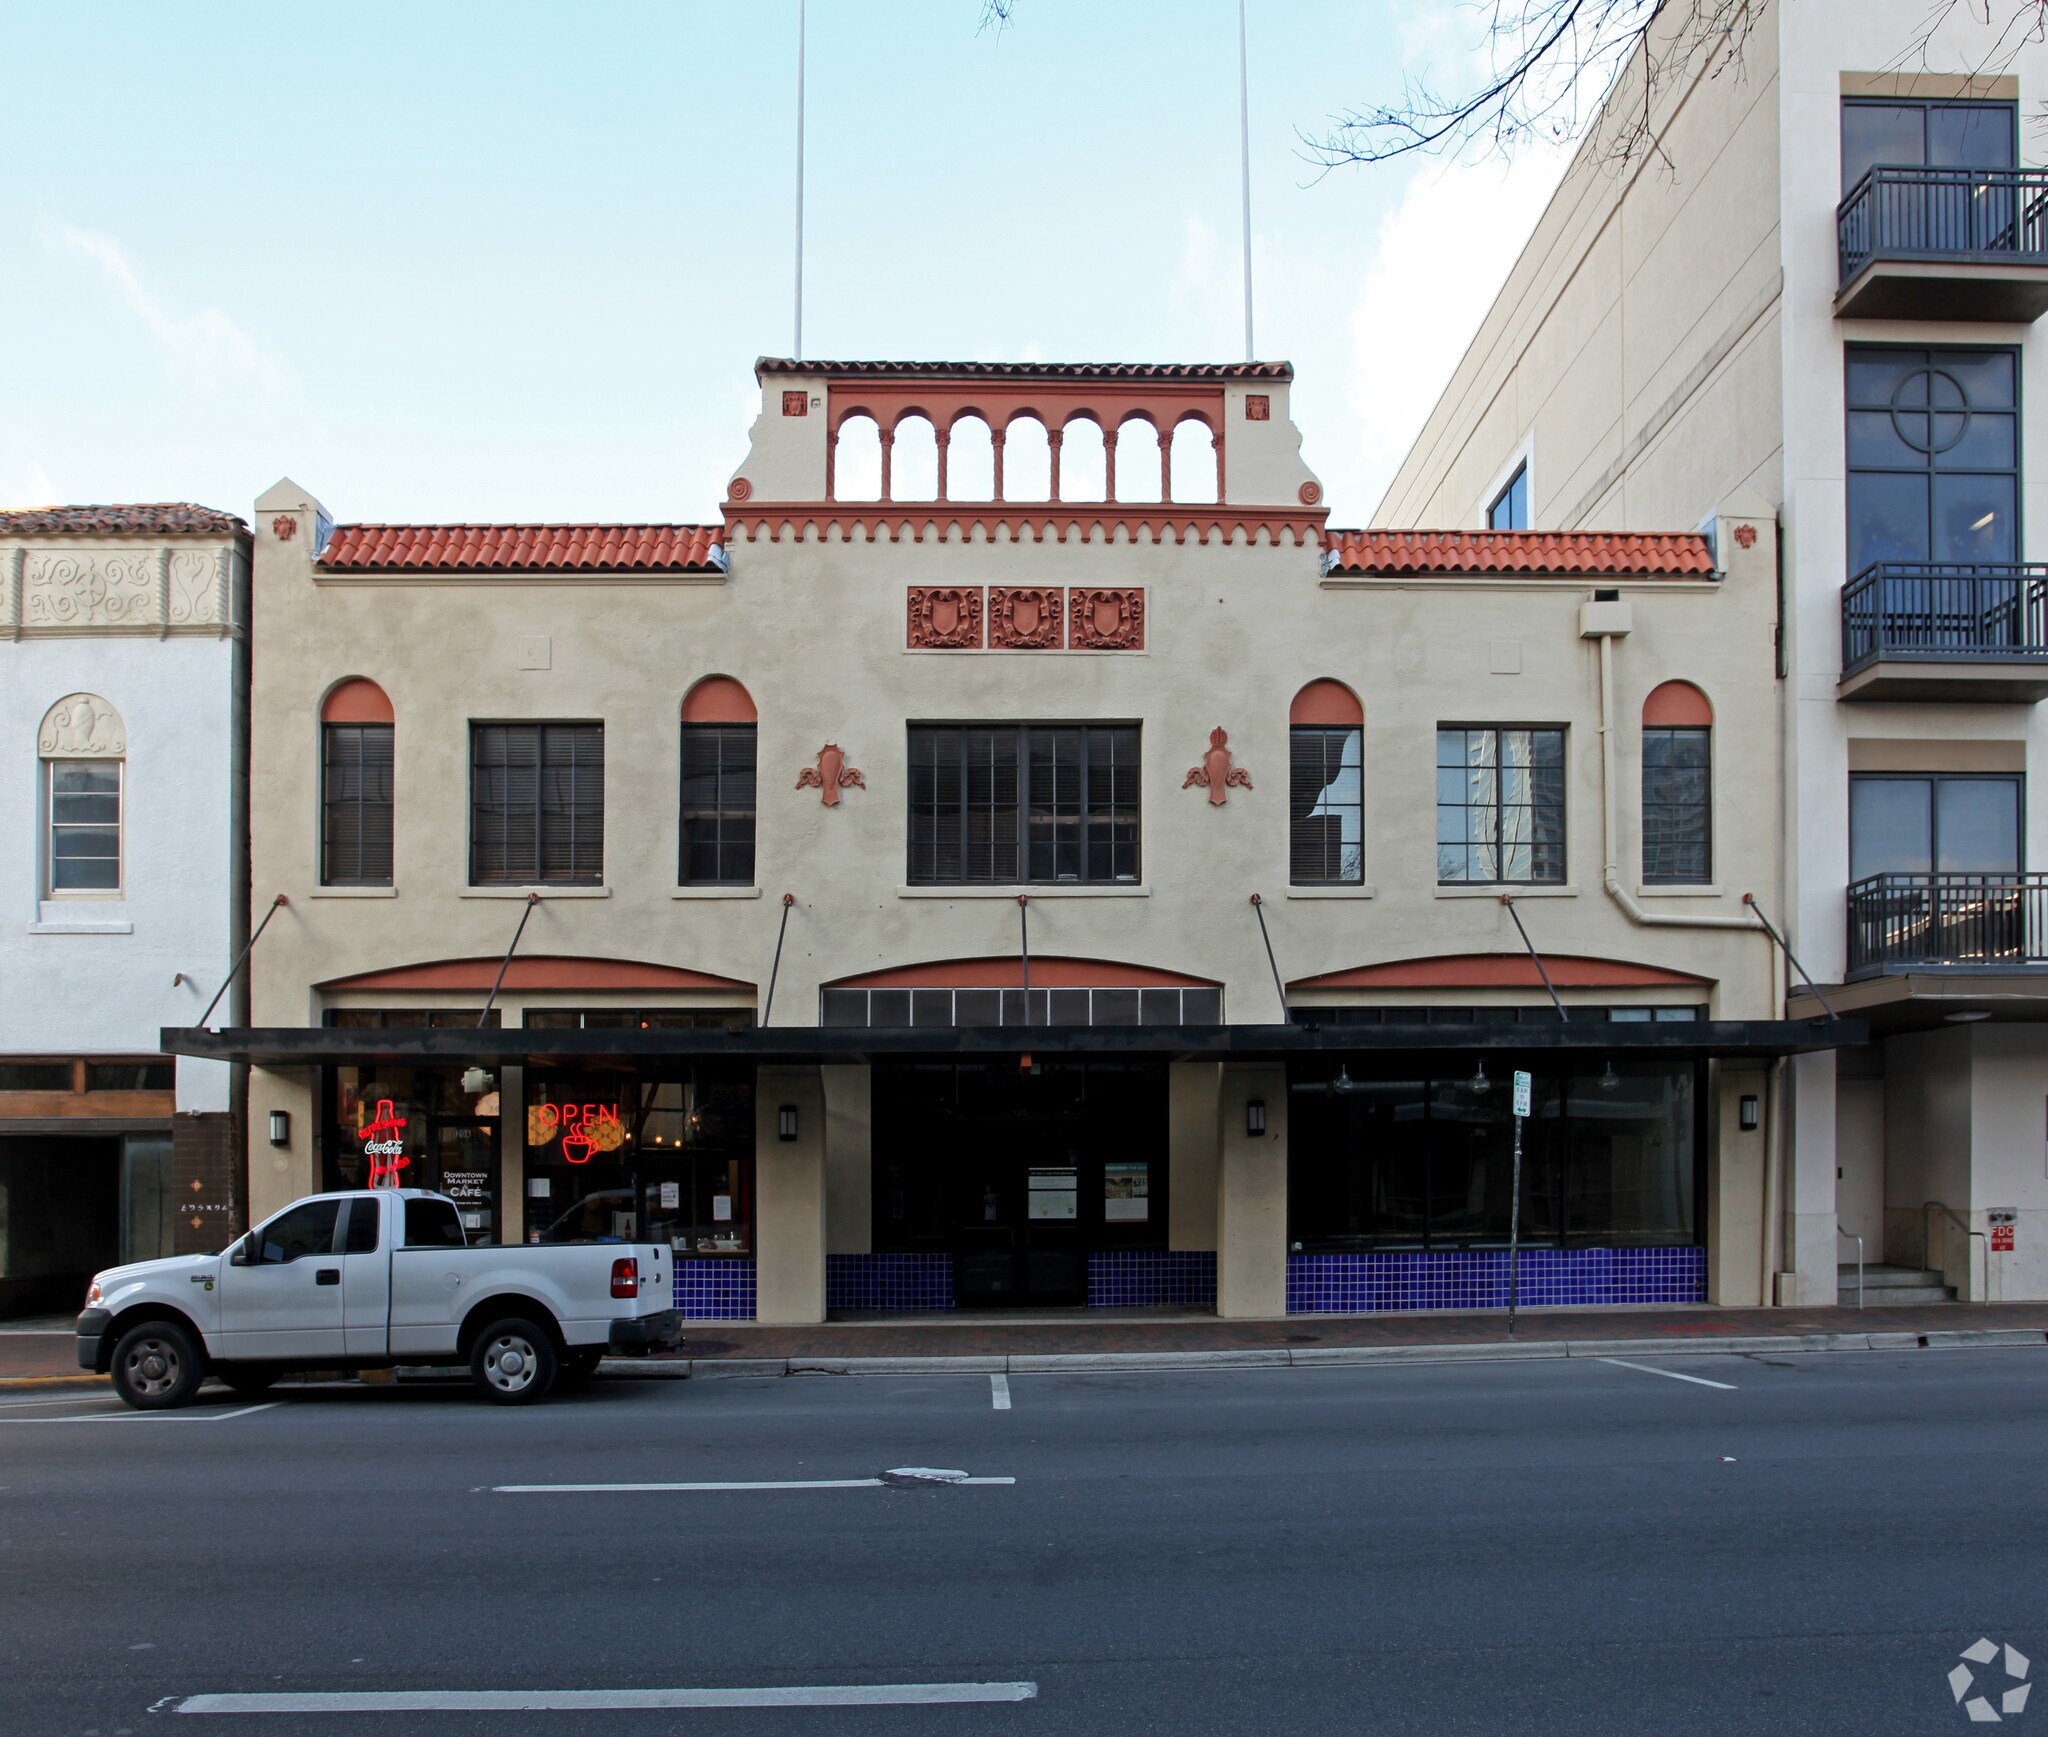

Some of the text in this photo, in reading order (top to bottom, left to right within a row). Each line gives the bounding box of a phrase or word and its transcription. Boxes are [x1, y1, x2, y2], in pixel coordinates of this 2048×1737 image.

[539, 1103, 617, 1127] OPEN
[450, 1186, 482, 1197] CAFÉ
[1991, 1226, 2014, 1236] FDC
